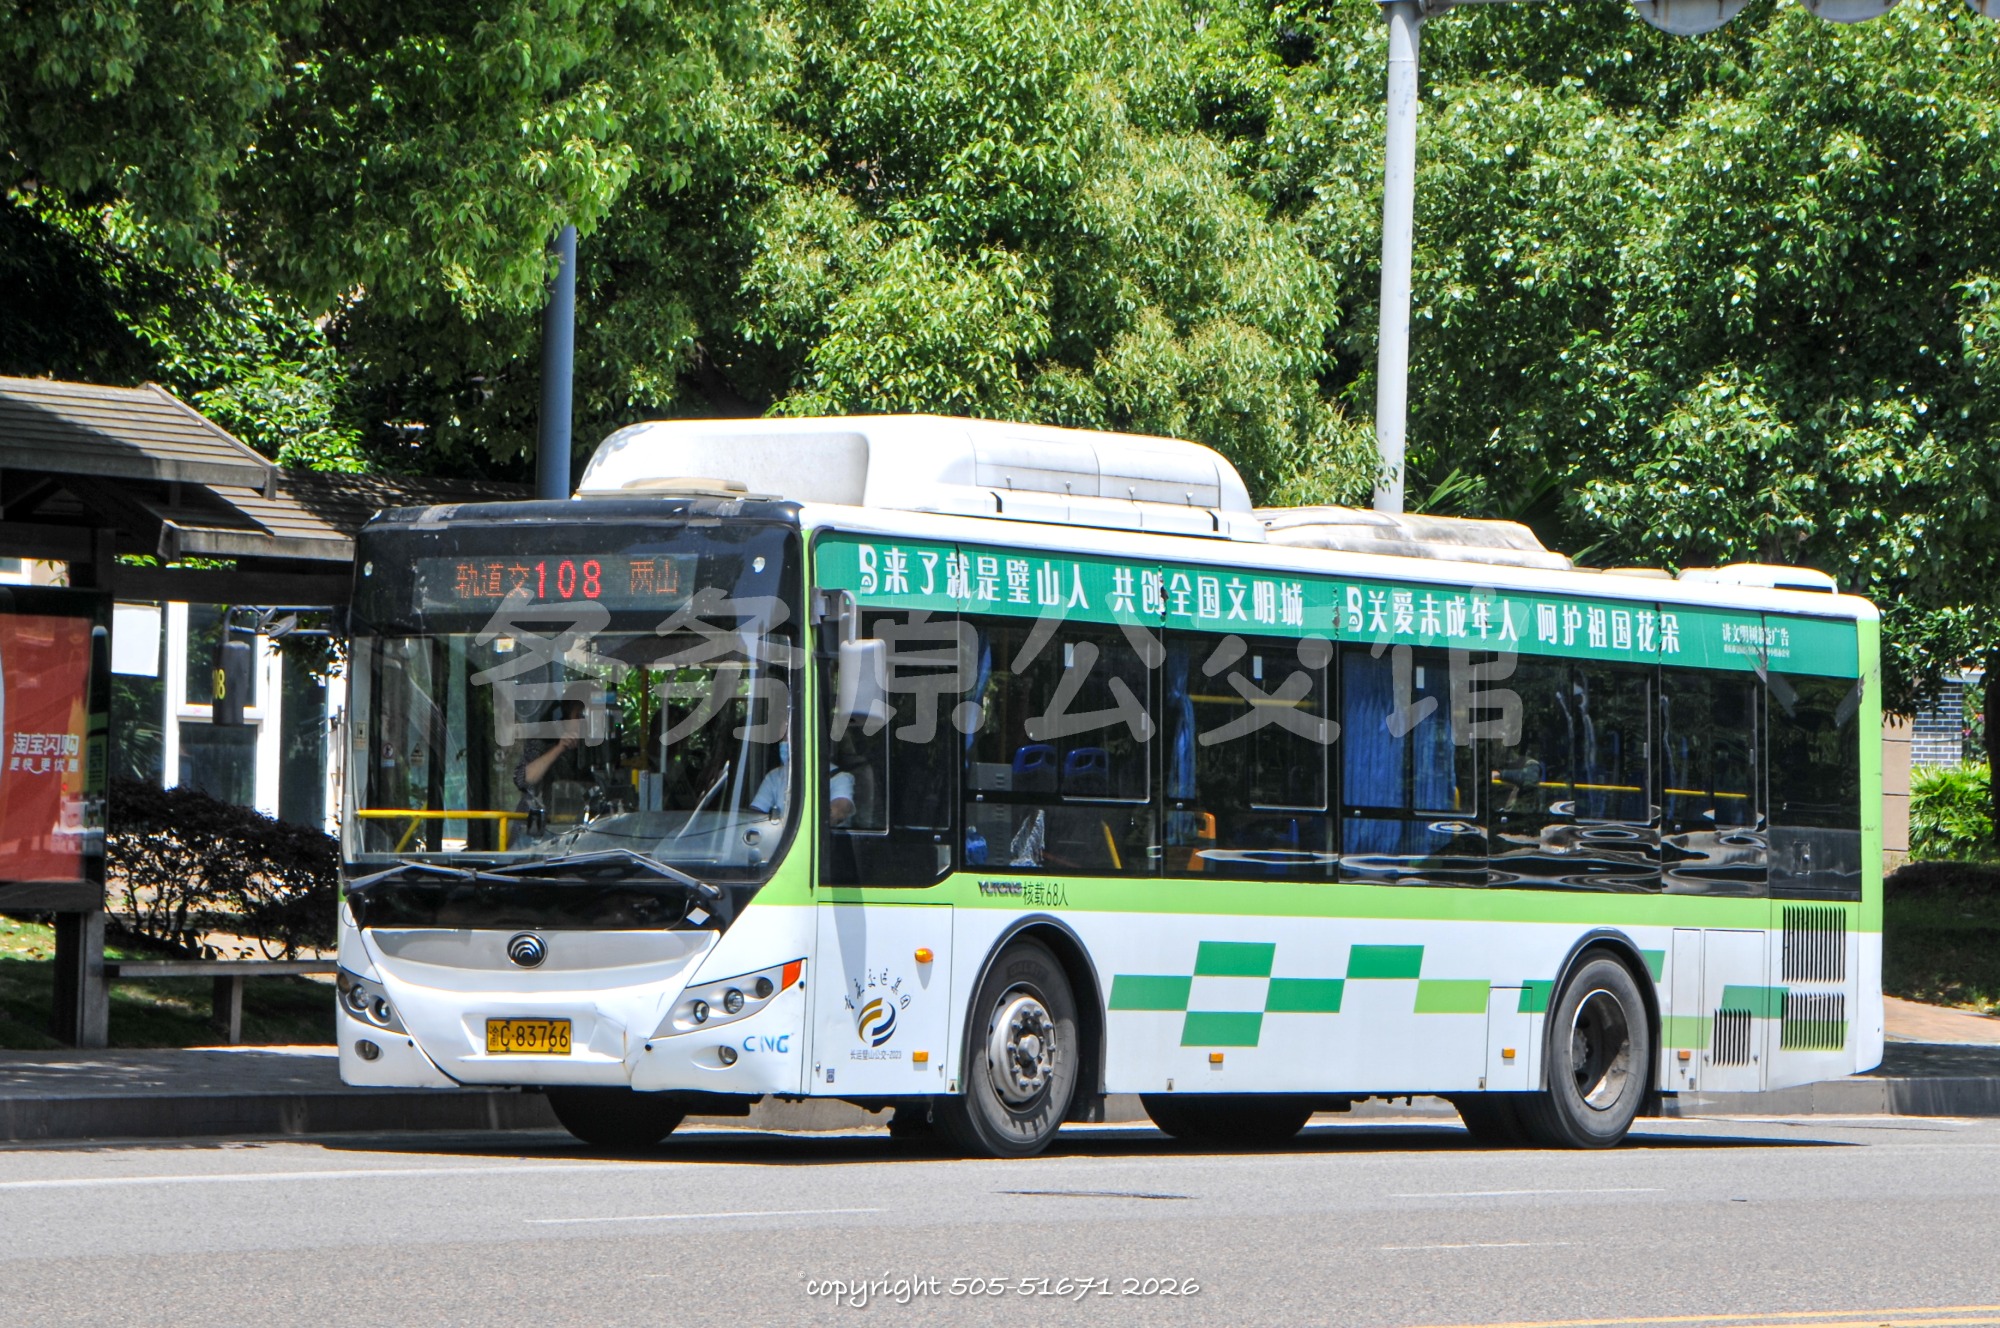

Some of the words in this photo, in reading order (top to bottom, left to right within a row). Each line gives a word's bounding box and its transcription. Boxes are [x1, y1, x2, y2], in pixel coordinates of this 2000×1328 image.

[535, 560, 601, 598] 108
[1536, 603, 1681, 653] 呵护祖国花朵
[12, 732, 79, 756] 淘宝闪购
[1022, 881, 1069, 906] 核载68人
[743, 1035, 789, 1053] CNG
